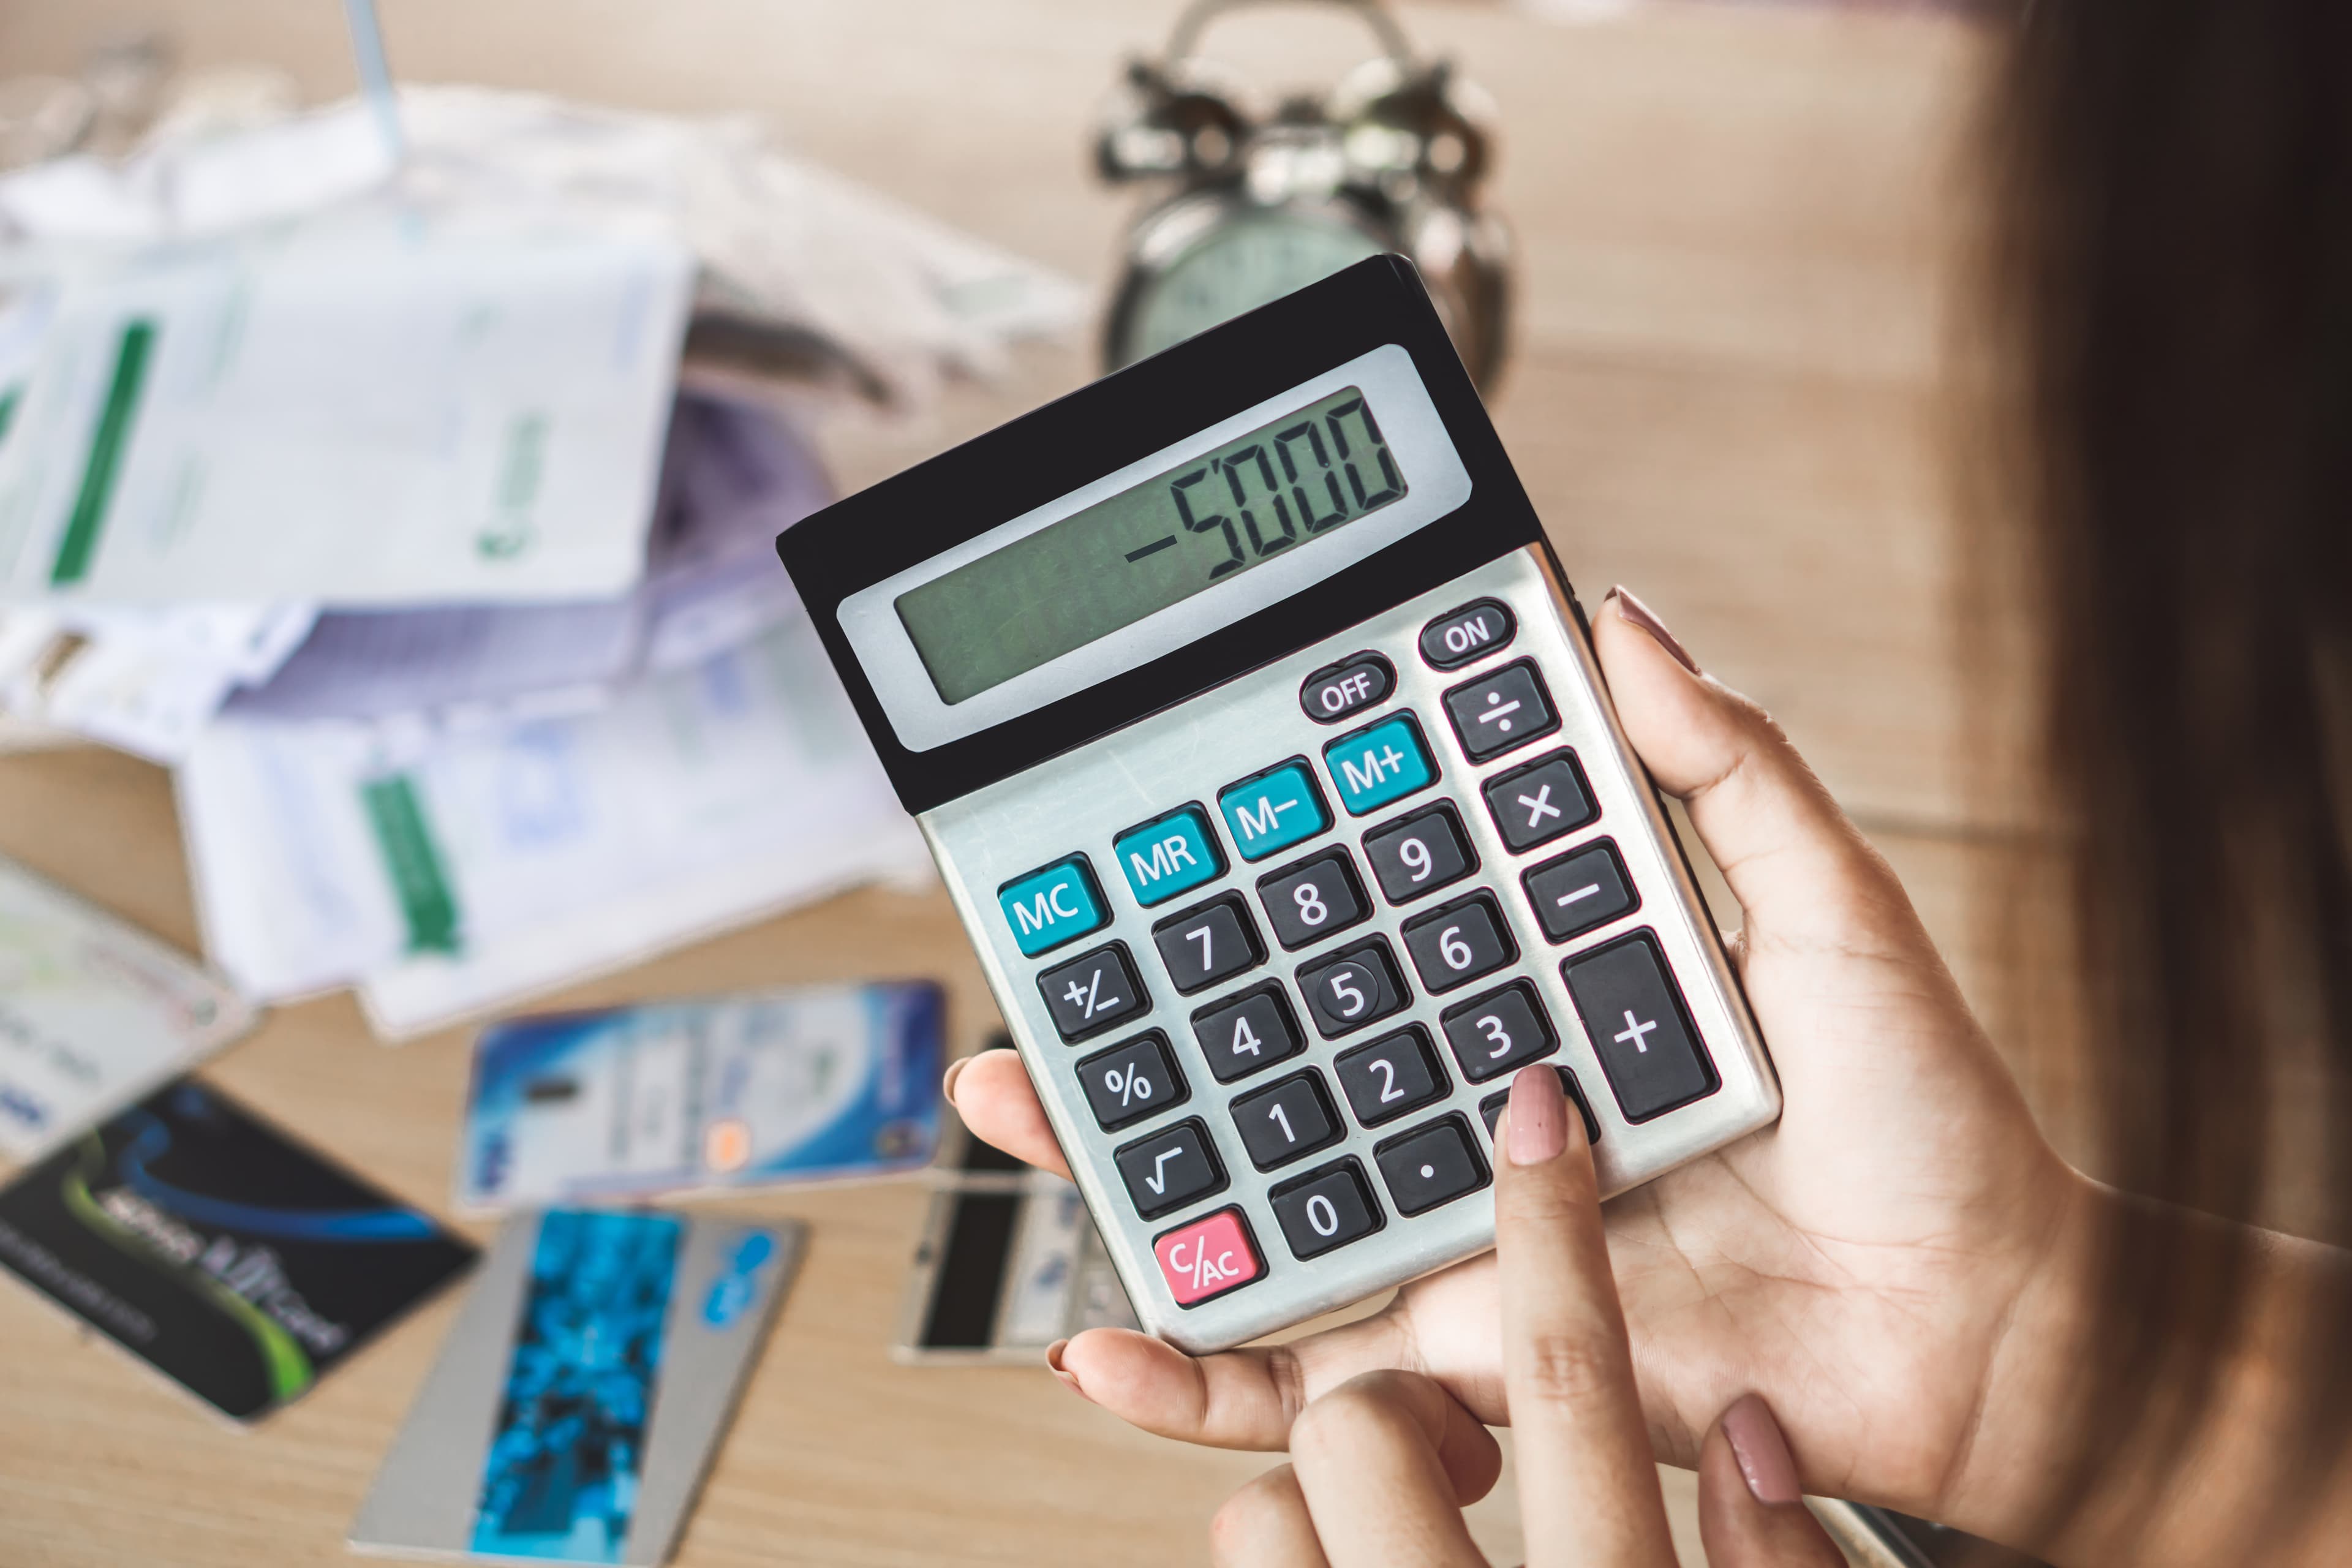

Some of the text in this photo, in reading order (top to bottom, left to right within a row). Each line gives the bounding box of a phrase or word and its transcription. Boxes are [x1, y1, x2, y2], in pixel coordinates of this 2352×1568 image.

[1445, 616, 1490, 652] ON
[1321, 672, 1371, 712] OFF
[1341, 745, 1403, 794] M+
[1129, 835, 1197, 886] MR
[1400, 838, 1431, 882] 9
[1012, 883, 1079, 935] MC
[1294, 883, 1327, 925] 8
[1185, 925, 1212, 971] 7
[1440, 926, 1472, 970] 6
[1330, 971, 1364, 1017] 5
[1232, 1016, 1261, 1056] 4
[1476, 1016, 1511, 1058] 3
[1104, 1062, 1152, 1106] %
[1368, 1059, 1404, 1103] 2
[1268, 1103, 1295, 1142] 1
[1306, 1195, 1338, 1236] 0
[1168, 1235, 1239, 1290] C/AC
